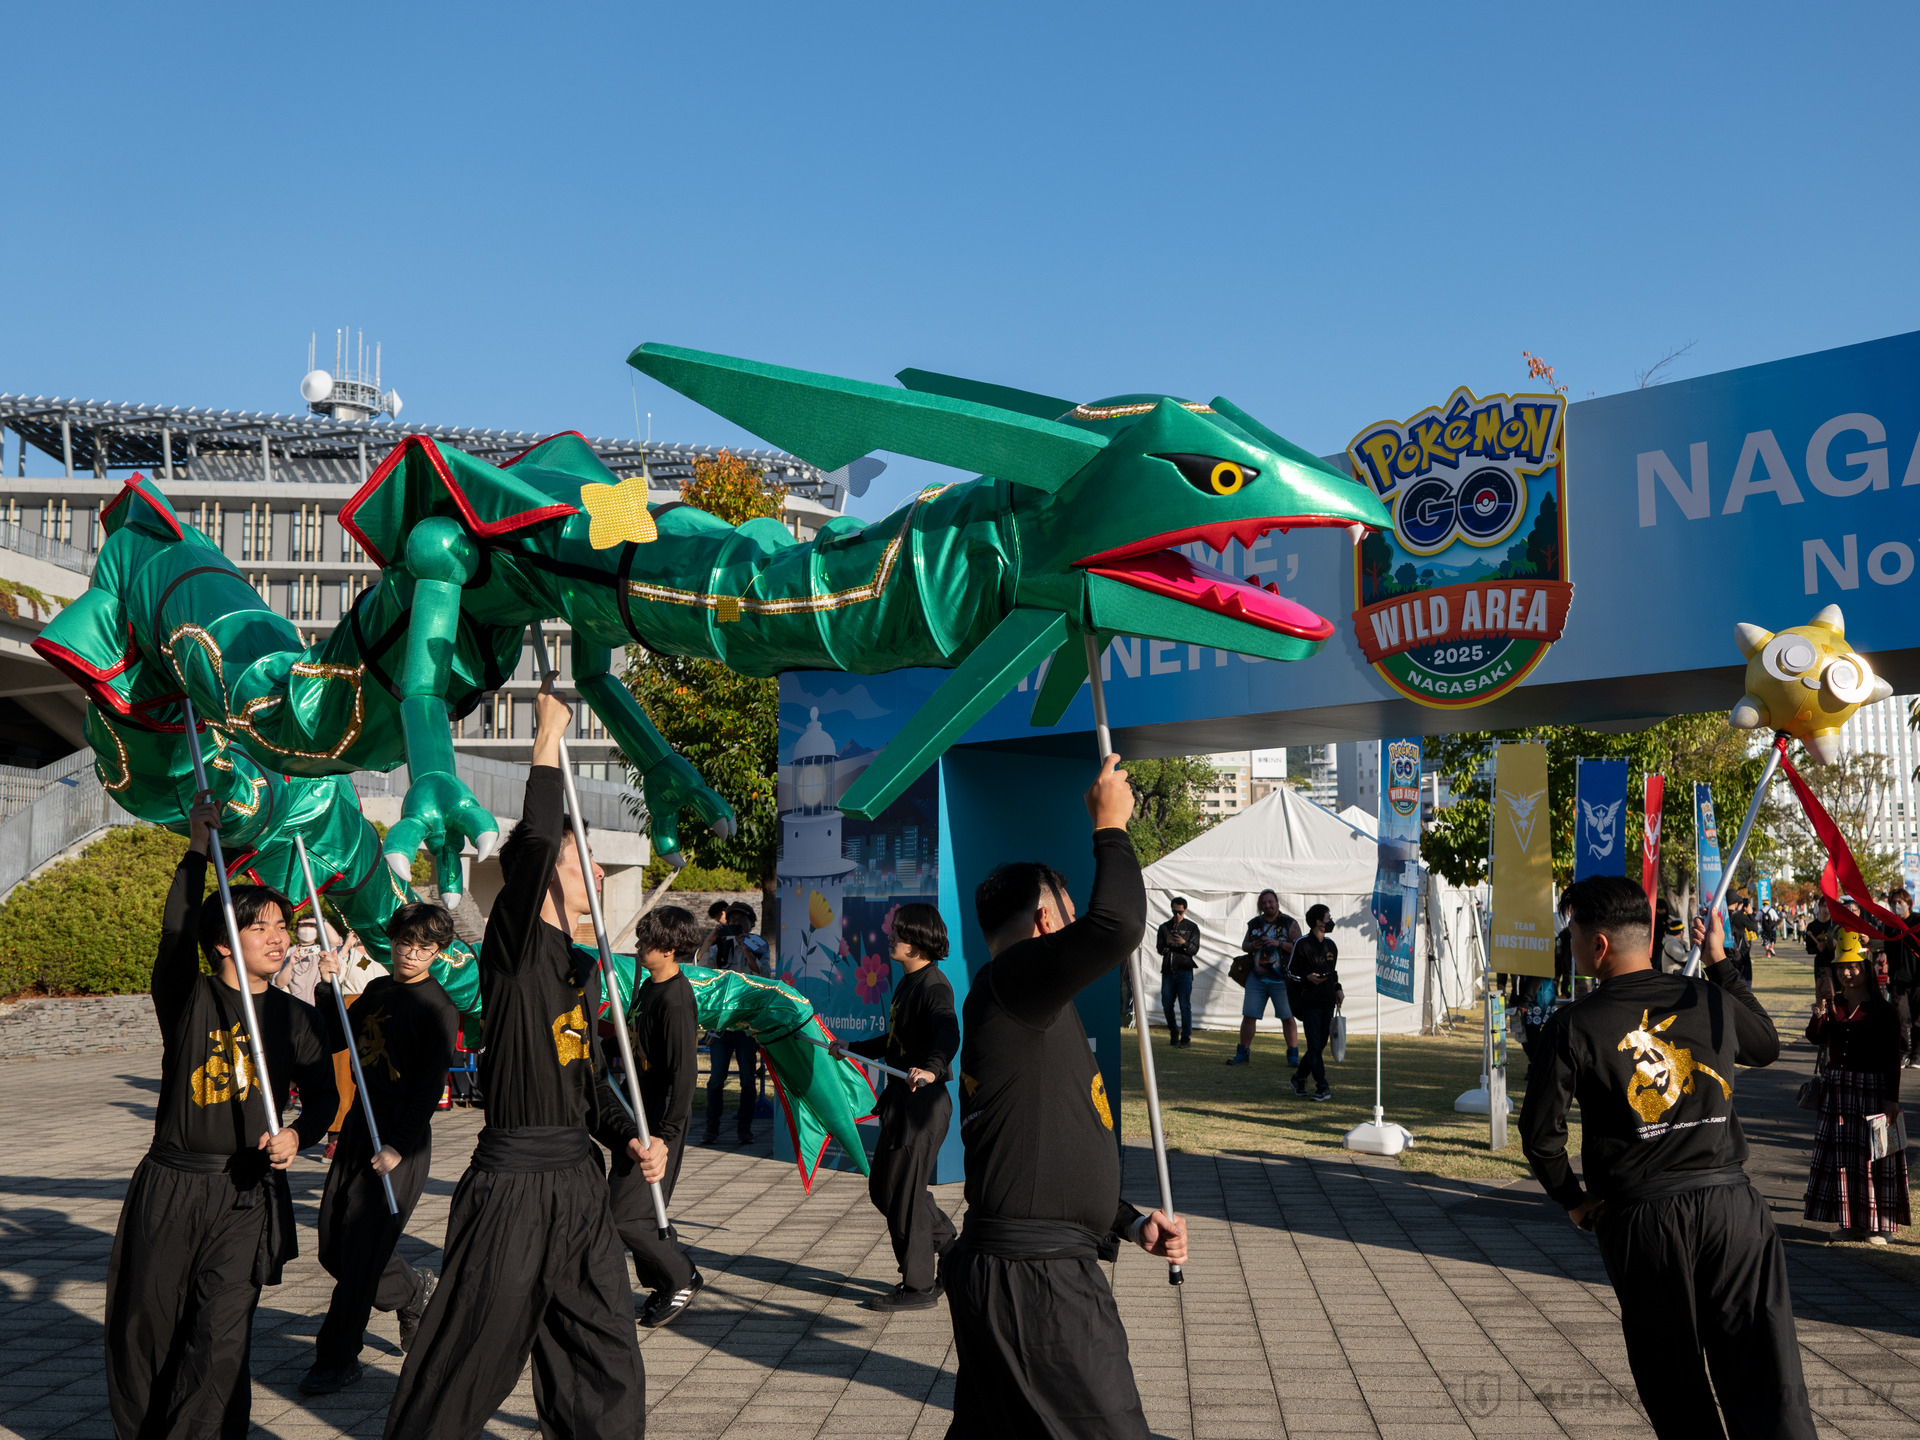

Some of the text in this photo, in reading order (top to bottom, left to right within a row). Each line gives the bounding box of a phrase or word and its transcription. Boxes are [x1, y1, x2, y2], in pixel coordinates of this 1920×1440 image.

[1401, 467, 1517, 547] GO
[1802, 533, 1920, 595] No
[1369, 588, 1548, 650] WILD AREA
[1433, 645, 1483, 665] 2025
[1407, 660, 1513, 694] NAGASAKI
[1390, 788, 1403, 800] WILD
[1514, 921, 1536, 932] TEAM
[1495, 934, 1551, 952] INSTINCT
[817, 1012, 886, 1032] November 7-9
